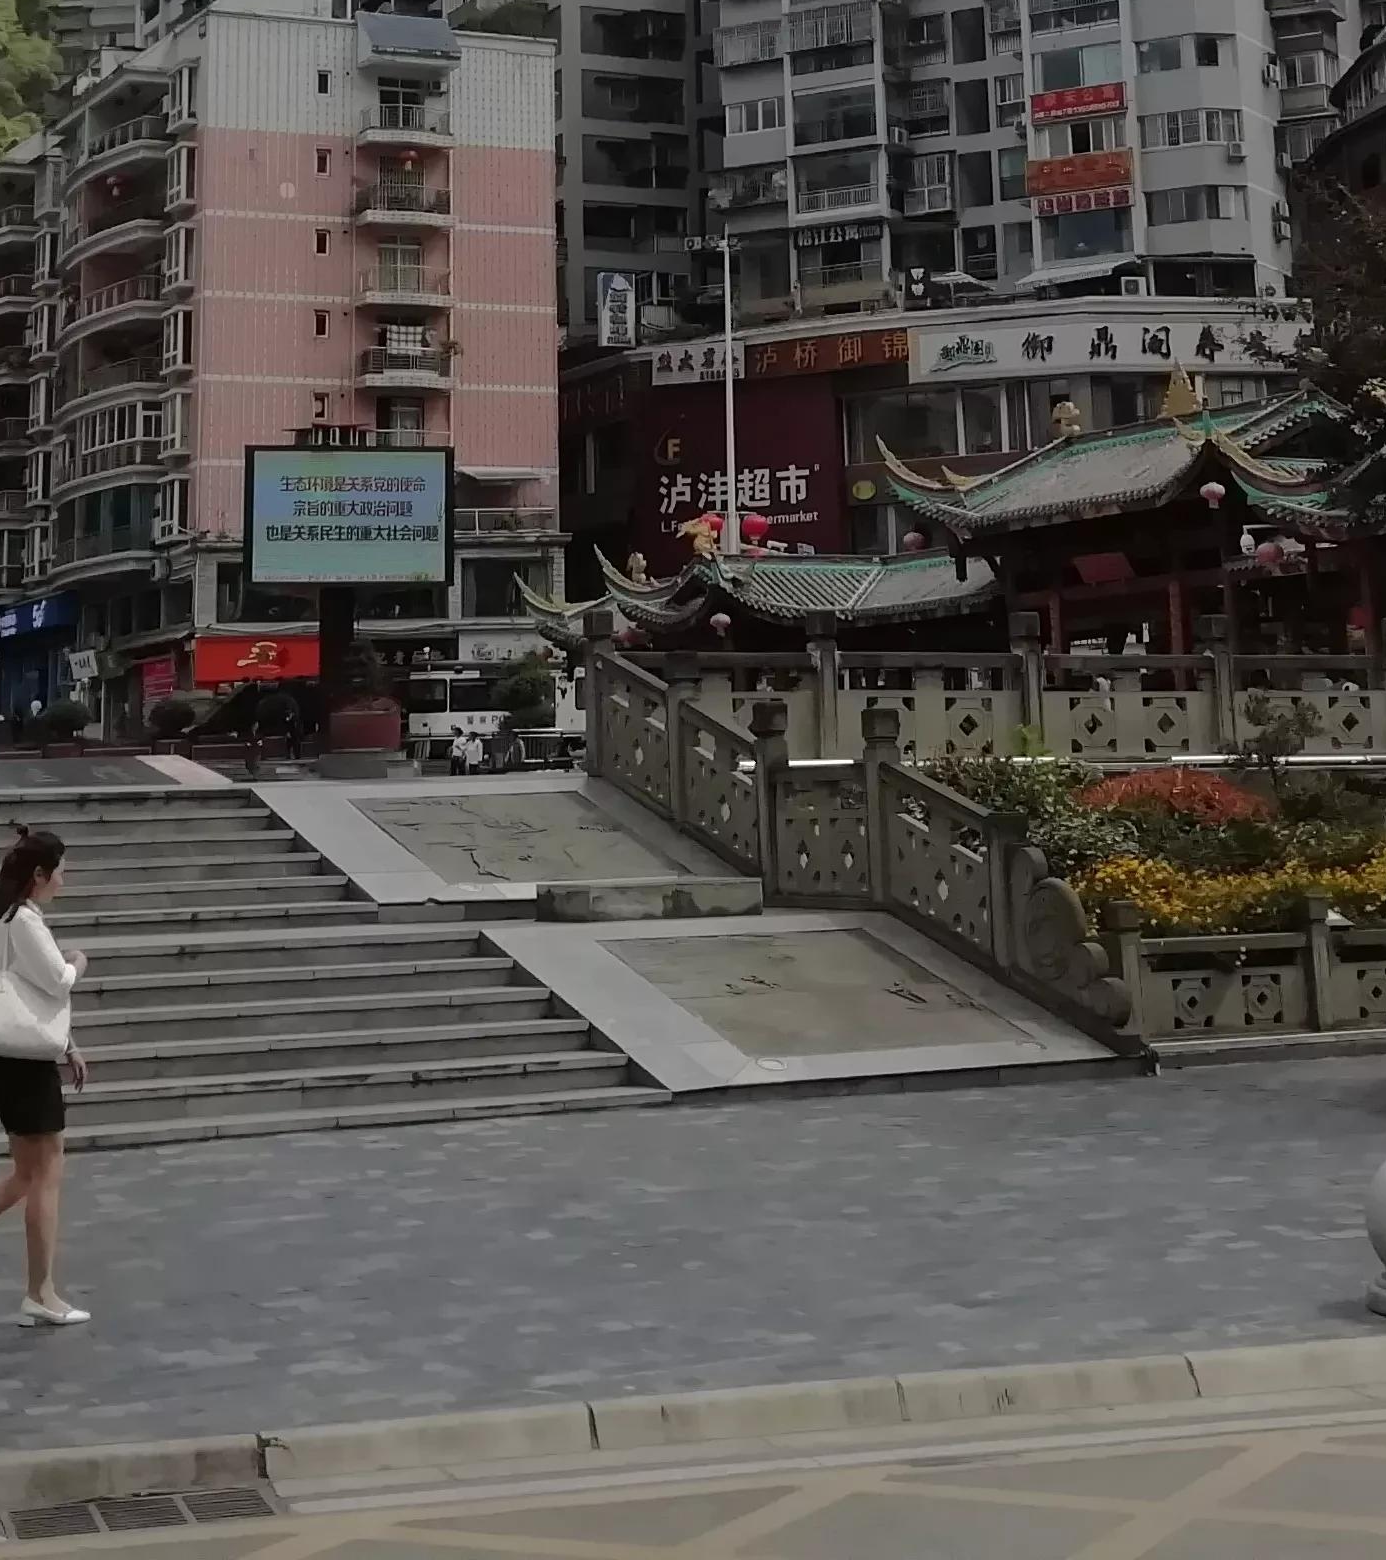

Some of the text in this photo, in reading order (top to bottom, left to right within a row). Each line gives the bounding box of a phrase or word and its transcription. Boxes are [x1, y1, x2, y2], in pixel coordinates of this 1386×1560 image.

[754, 328, 909, 374] 泸桥御锦
[279, 475, 427, 493] 生态环境是关系党的使命
[293, 500, 414, 518] 宗旨的重大政治问题
[266, 524, 440, 543] 也是关系民生的重大社会问题
